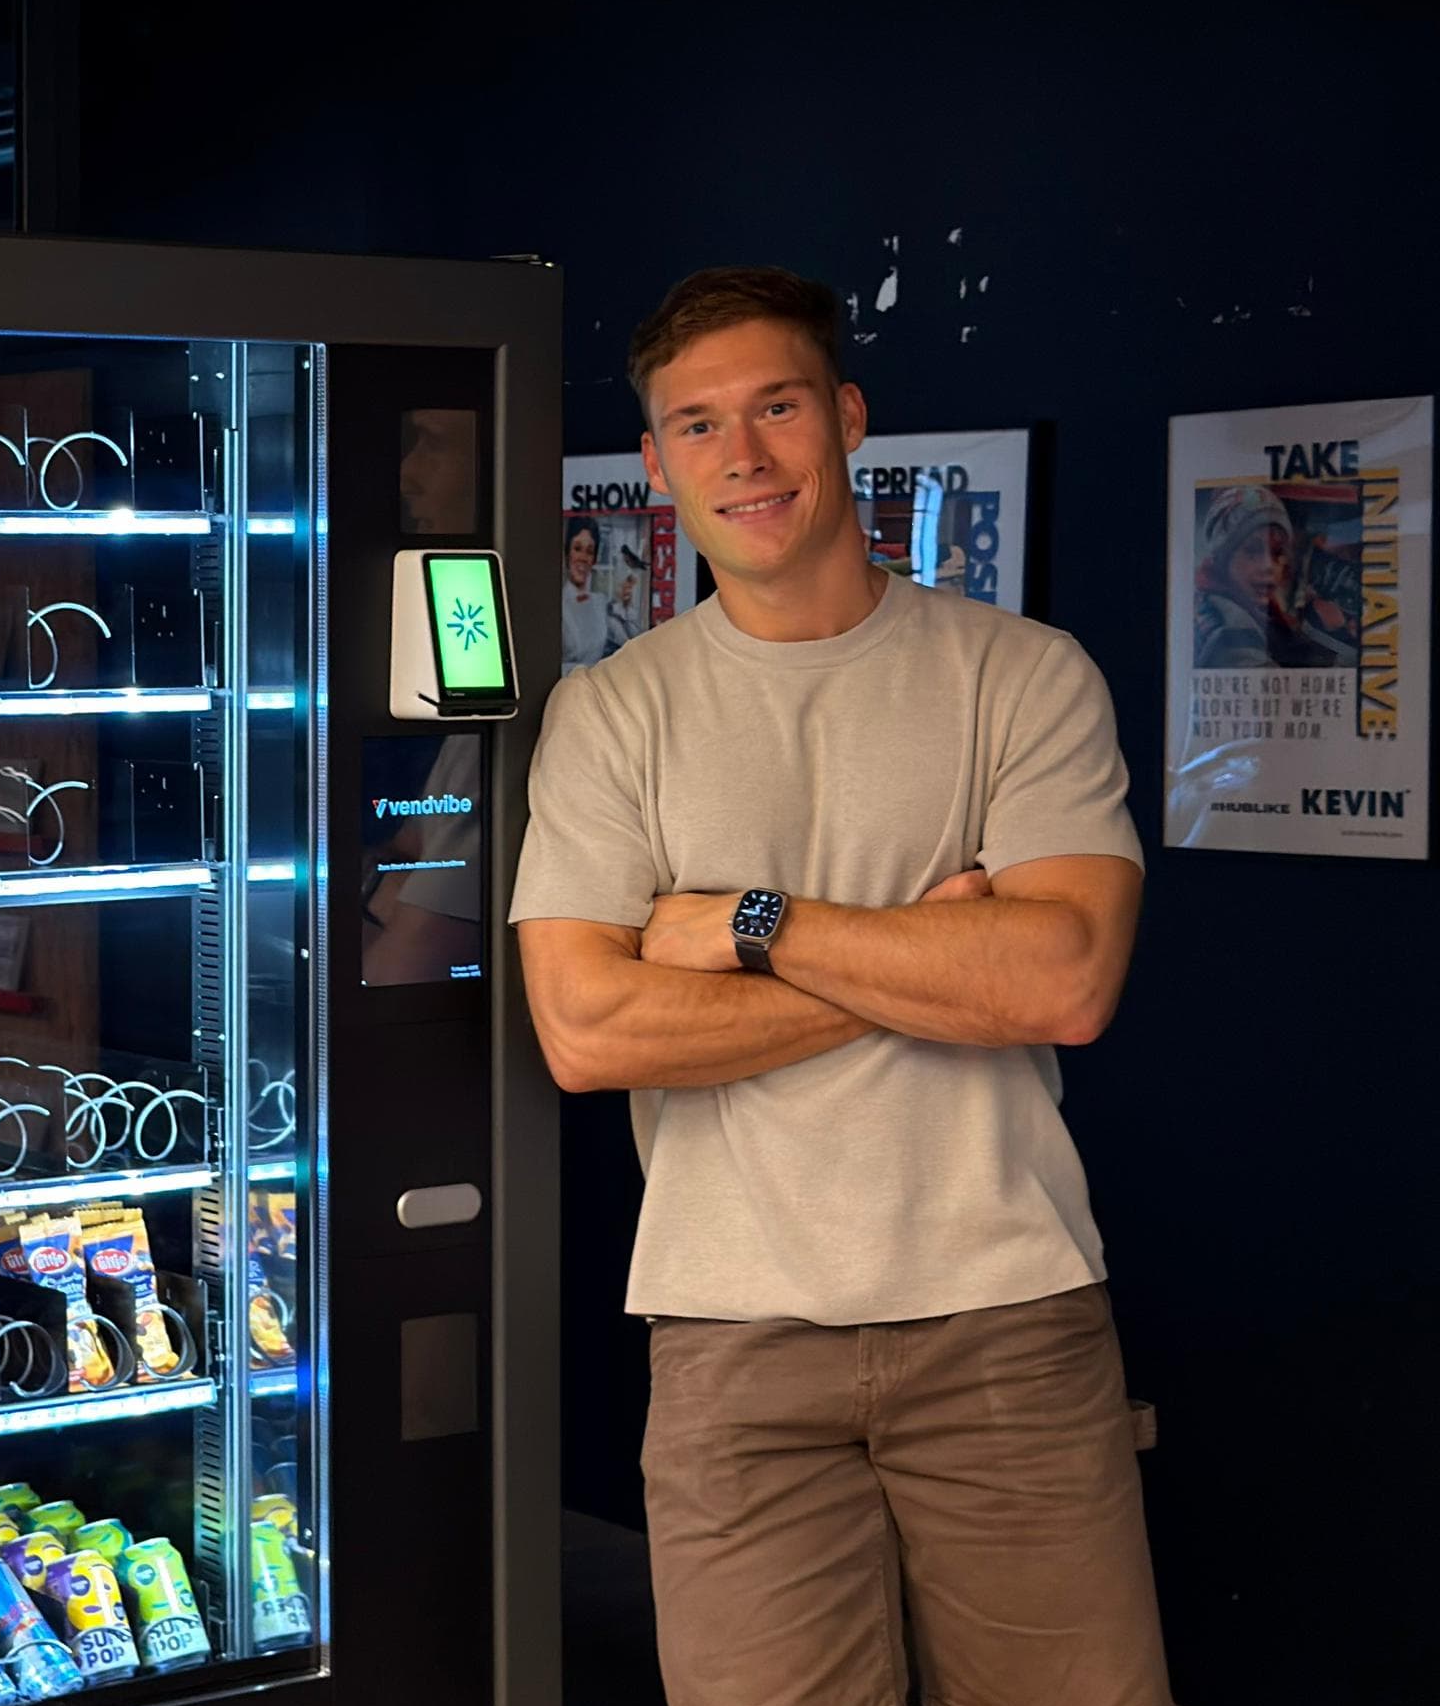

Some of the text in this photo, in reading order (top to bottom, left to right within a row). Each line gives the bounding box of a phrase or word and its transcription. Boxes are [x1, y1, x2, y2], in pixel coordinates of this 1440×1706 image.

[1265, 440, 1359, 480] TAKE
[570, 481, 652, 512] SHOW
[1192, 676, 1347, 695] YOU'RE NOT HOME
[1193, 698, 1342, 717] ALONE BUT WE'RE
[1193, 721, 1221, 738] NOT
[1232, 721, 1273, 738] YOUR
[388, 794, 472, 816] vendvibe
[86, 1645, 125, 1669] POP
